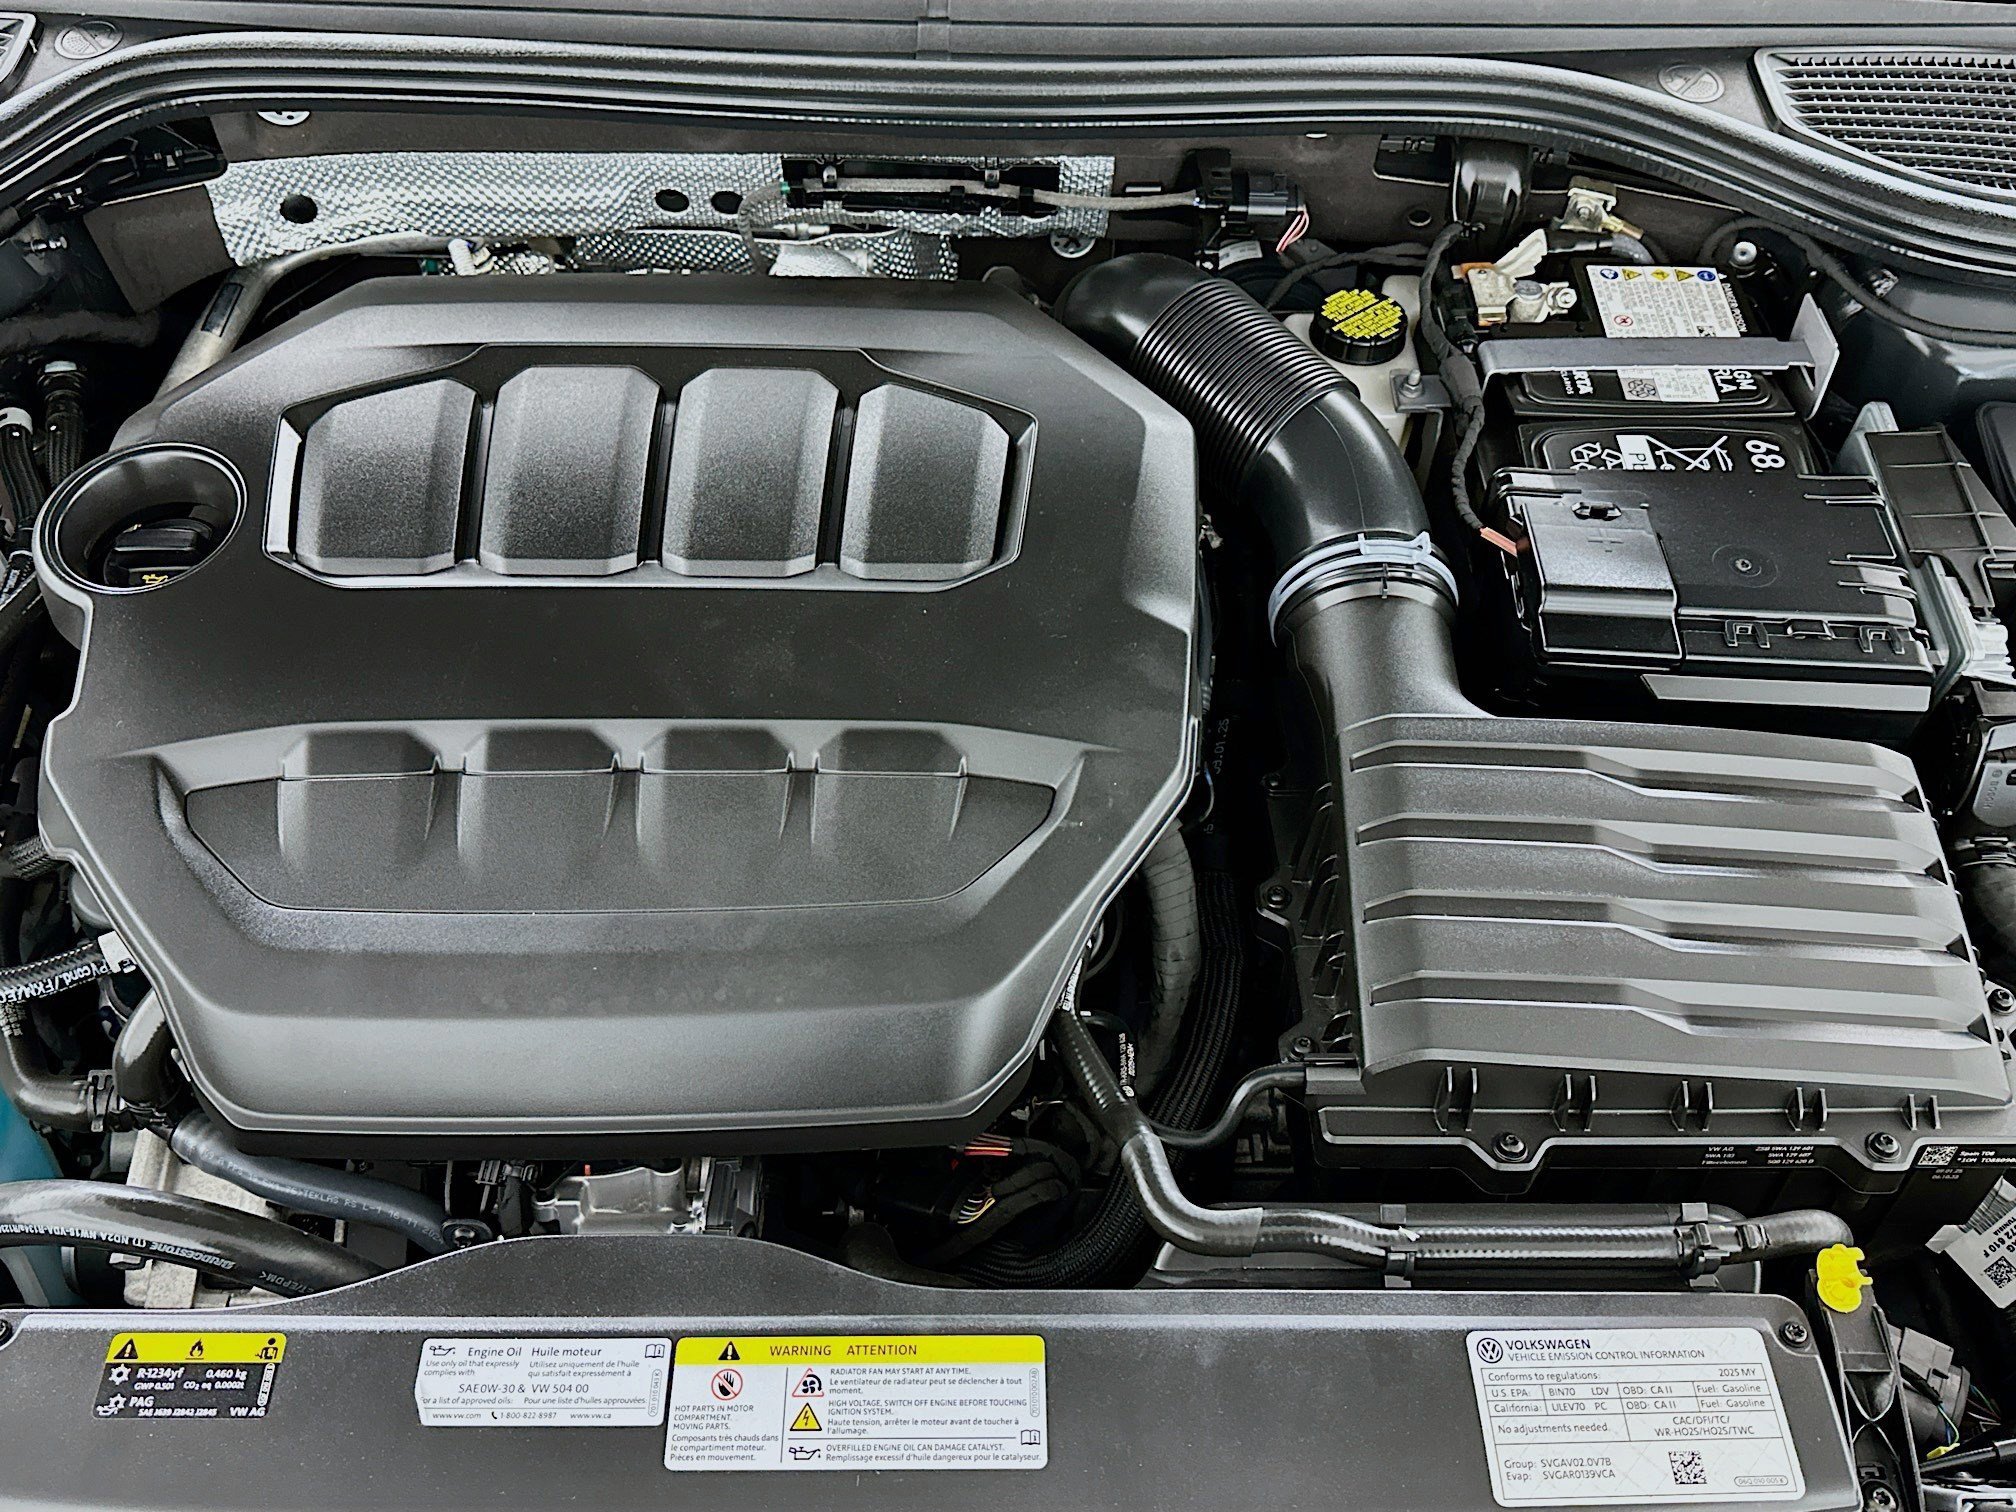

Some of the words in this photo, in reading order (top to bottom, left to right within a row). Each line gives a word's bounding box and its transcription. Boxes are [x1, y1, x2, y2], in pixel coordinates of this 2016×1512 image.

[1573, 371, 1593, 394] RTA
[1714, 369, 1738, 393] RLA
[1733, 371, 1757, 390] GM
[150, 1241, 236, 1269] BRIDGESTONE
[1505, 1339, 1591, 1351] VOLKSWAGEN
[468, 1347, 504, 1359] Engine
[506, 1347, 522, 1357] Oil
[531, 1347, 560, 1357] Huile
[562, 1347, 602, 1357] moteur
[769, 1346, 832, 1356] WARNING
[846, 1345, 917, 1356] ATTENTION
[1507, 1353, 1547, 1362] VEHICLE
[1547, 1352, 1594, 1361] EMISSION
[1594, 1351, 1639, 1360] CONTROL
[1639, 1350, 1705, 1359] INFORMATION
[440, 1360, 458, 1370] only
[468, 1360, 484, 1370] that
[485, 1360, 520, 1370] expressly
[529, 1360, 557, 1368] Utilisez
[558, 1360, 605, 1370] uniquement
[616, 1360, 640, 1368] l'huile
[136, 1367, 185, 1382] R-1234yf
[234, 1369, 248, 1381] kg
[423, 1369, 457, 1378] complies
[527, 1371, 540, 1379] qui
[541, 1369, 572, 1377] satisfait
[830, 1368, 867, 1376] RADIATOR
[868, 1367, 883, 1375] FAN
[901, 1367, 924, 1375] START
[935, 1367, 951, 1375] ANY
[1718, 1368, 1740, 1377] 2025
[1740, 1368, 1756, 1376] MY
[829, 1378, 839, 1386] Le
[840, 1378, 881, 1386] ventilateur
[893, 1377, 928, 1385] radiateur
[929, 1378, 946, 1387] peut
[957, 1377, 999, 1385] déclencher
[1488, 1373, 1533, 1382] Conforms
[134, 1382, 155, 1391] GWP
[517, 1384, 526, 1394] &
[531, 1384, 551, 1394] VW
[552, 1384, 573, 1394] 504
[575, 1384, 589, 1394] 00
[1650, 1386, 1665, 1395] CA
[1722, 1384, 1761, 1393] Gasoline
[1548, 1388, 1576, 1397] BIN70
[1590, 1387, 1609, 1396] LDV
[128, 1396, 155, 1407] PAG
[460, 1397, 497, 1405] approved
[523, 1397, 541, 1405] Pour
[828, 1399, 847, 1407] HIGH
[884, 1399, 913, 1407] SWITCH
[914, 1399, 928, 1407] OFF
[930, 1399, 957, 1407] ENGINE
[959, 1399, 988, 1407] BEFORE
[989, 1399, 1028, 1407] TOUCHING
[1653, 1401, 1668, 1410] CA
[1725, 1399, 1765, 1408] Gasoline
[229, 1407, 249, 1417] VW
[248, 1407, 267, 1417] AG
[674, 1405, 691, 1413] HOT
[692, 1405, 715, 1413] PARTS
[726, 1405, 754, 1413] MOTOR
[828, 1408, 862, 1416] IGNITION
[1551, 1402, 1586, 1412] ULEV70
[1594, 1402, 1608, 1411] PC
[673, 1423, 704, 1431] MOVING
[827, 1418, 851, 1426] Haute
[884, 1418, 910, 1426] arrêter
[949, 1418, 971, 1426] avant
[983, 1418, 1013, 1426] toucher
[1497, 1425, 1512, 1434] No
[1513, 1424, 1572, 1436] adjustments
[671, 1434, 717, 1443] Composants
[733, 1434, 760, 1442] chauds
[761, 1434, 779, 1442] dans
[679, 1444, 735, 1453] compartiment
[826, 1444, 872, 1452] OVERFILLED
[873, 1444, 902, 1452] ENGINE
[903, 1444, 916, 1452] OIL
[917, 1444, 933, 1452] CAN
[934, 1443, 966, 1452] DAMAGE
[670, 1453, 694, 1461] Pièces
[825, 1453, 873, 1463] Remplissage
[874, 1453, 905, 1462] excessif
[905, 1453, 931, 1462] d'huile
[932, 1453, 972, 1463] dangereux
[973, 1454, 991, 1463] pour
